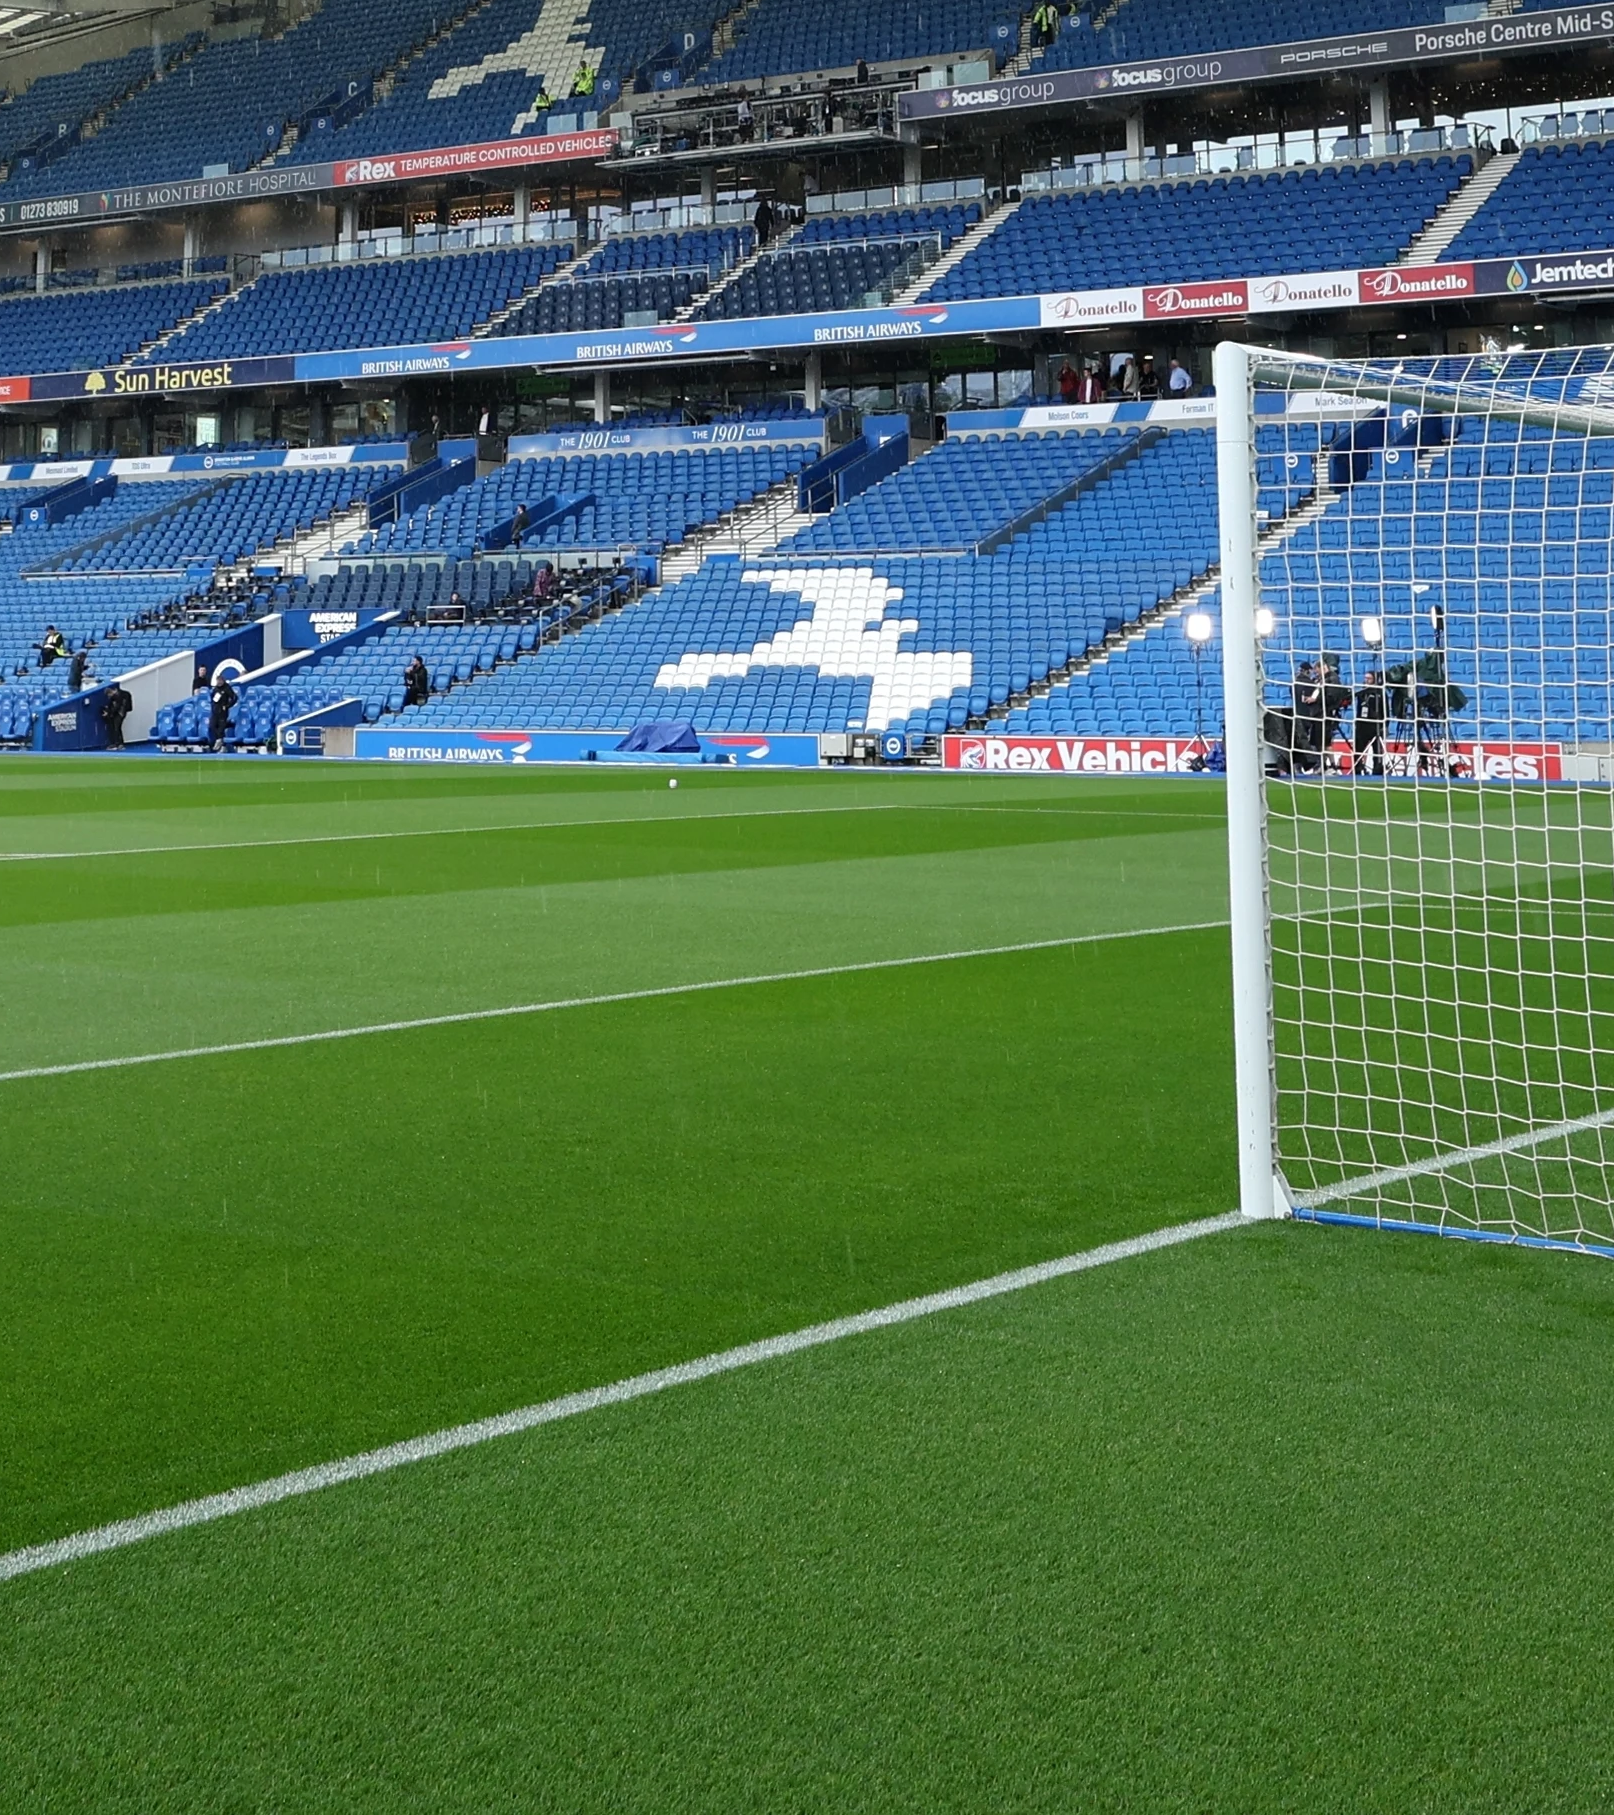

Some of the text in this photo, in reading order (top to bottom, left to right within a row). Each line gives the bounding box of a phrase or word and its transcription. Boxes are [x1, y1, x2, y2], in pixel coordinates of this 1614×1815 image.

[1280, 42, 1388, 64] PORSCHE
[1414, 30, 1487, 53] Porsche
[1490, 22, 1552, 44] Centre
[359, 134, 612, 181] Rex TEMPERATURE CONTROLLED VEHICLES
[114, 171, 316, 208] THE MONTEFIORE HOSPITAL
[20, 199, 79, 220] 01273 830919
[1253, 279, 1352, 305] Donatello
[1363, 271, 1468, 296] Donatello
[1046, 296, 1137, 320] Donatello
[1147, 288, 1243, 314] Donatello
[814, 321, 922, 342] BRITISH AIRWAYS
[576, 339, 673, 359] BRITISH AIRWAYS
[361, 356, 449, 374] BRITISH AIRWAYS
[114, 363, 232, 394] Sun Harvest
[1315, 396, 1368, 407] Mark Seaon
[1048, 410, 1089, 421] Molson Coors
[560, 432, 631, 449] THE 1901 CLUB
[692, 425, 767, 442] THE 1901 CLUB
[308, 612, 357, 623] AMERICAN
[314, 622, 357, 634] EXPRESS
[389, 747, 504, 761] BRITISH AIRWAYS
[987, 740, 1052, 769] Rex
